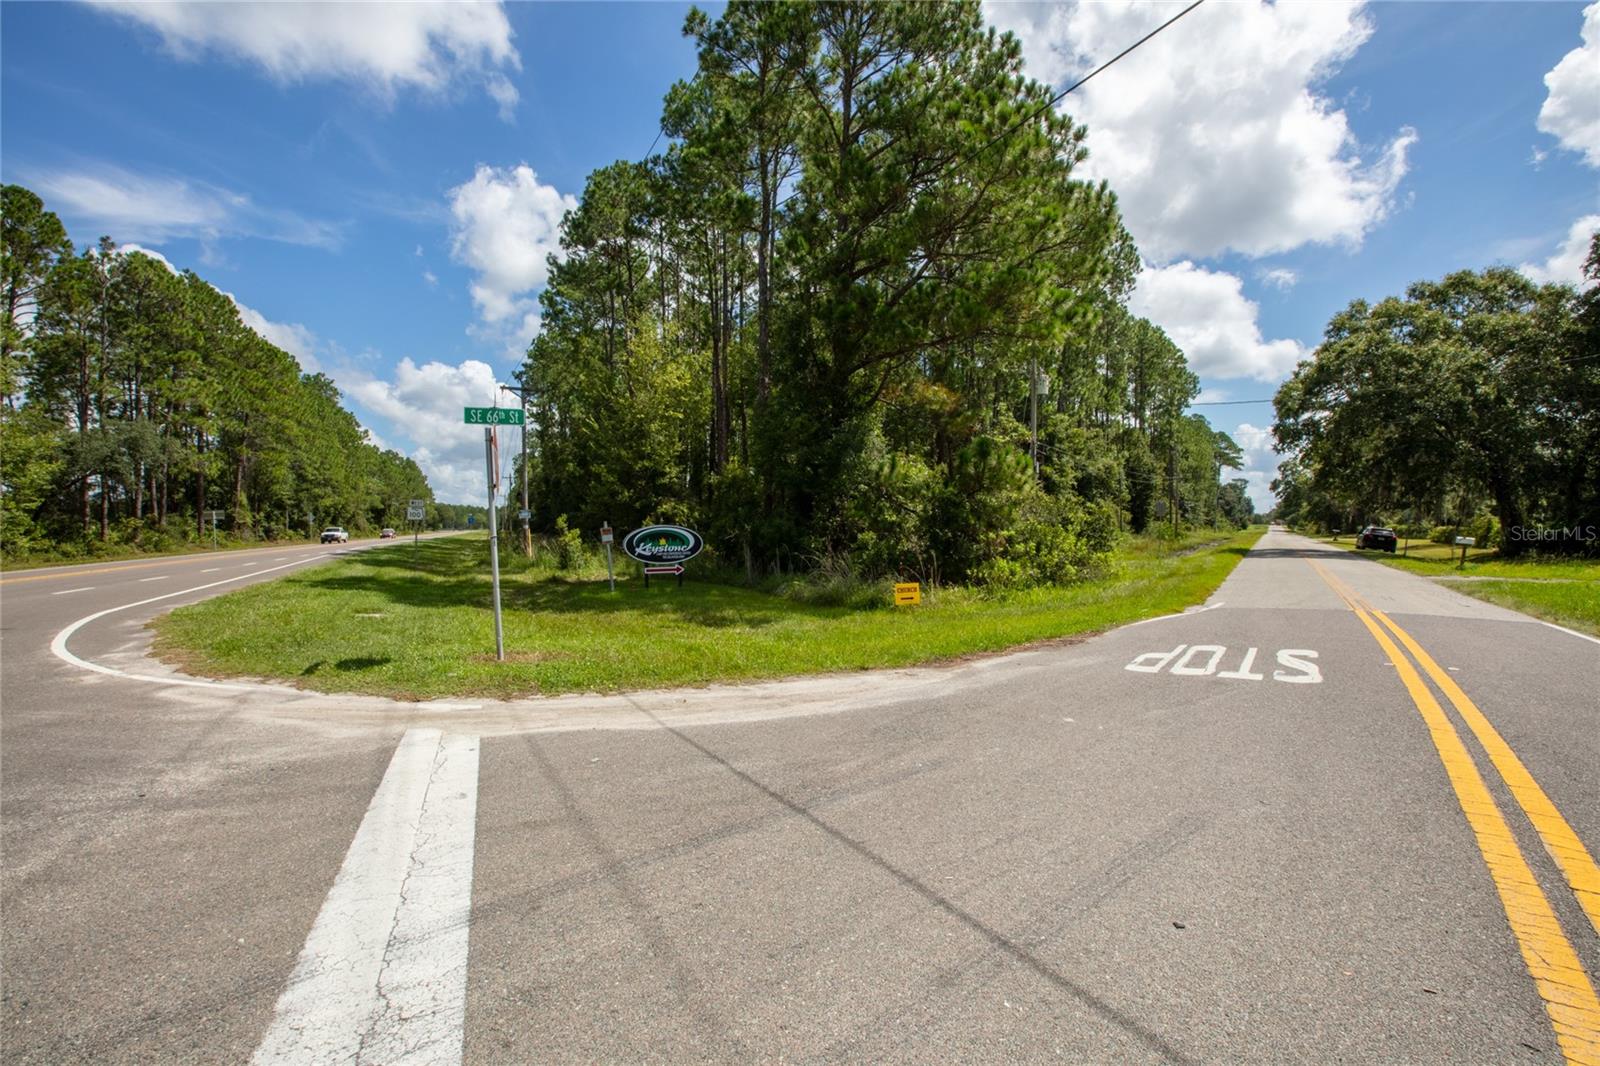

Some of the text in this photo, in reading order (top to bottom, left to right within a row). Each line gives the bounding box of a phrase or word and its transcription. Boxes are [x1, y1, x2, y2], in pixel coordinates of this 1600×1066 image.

[470, 409, 520, 424] SE 66th St
[634, 542, 690, 556] Keystone
[1124, 644, 1323, 684] STOP
